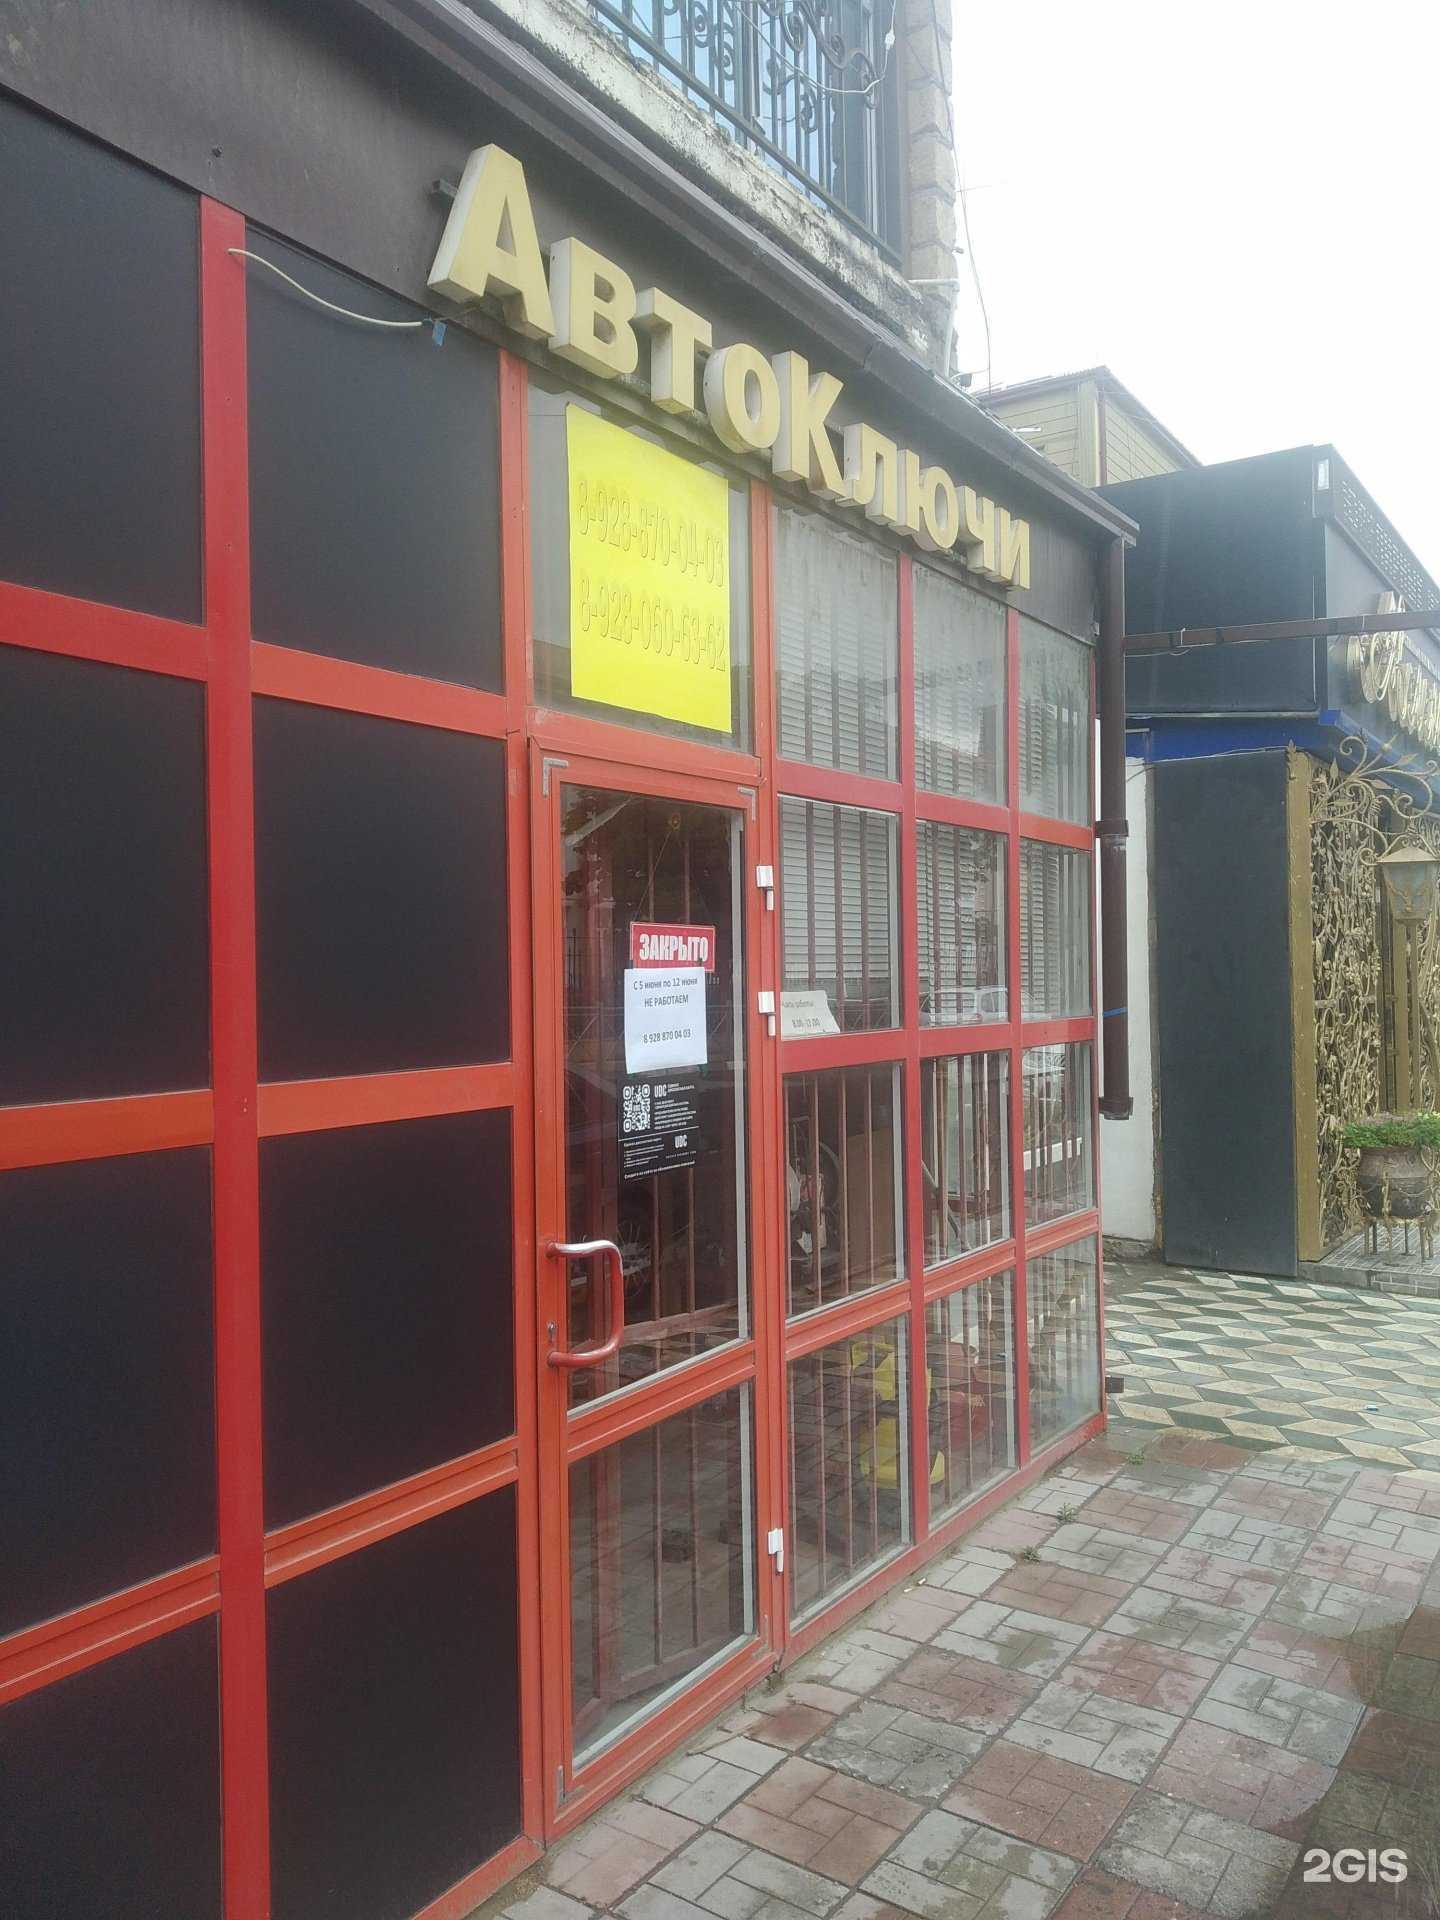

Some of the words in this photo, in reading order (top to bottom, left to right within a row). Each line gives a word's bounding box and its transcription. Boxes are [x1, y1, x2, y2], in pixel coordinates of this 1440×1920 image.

[640, 934, 708, 962] ЗАКРЫТО
[672, 978, 680, 986] 12
[644, 998, 653, 1007] НЕ
[655, 994, 688, 1006] РАБОТАЕМ
[649, 1033, 660, 1043] 928
[662, 1031, 673, 1041] 870
[674, 1030, 682, 1039] 04
[654, 1084, 667, 1098] UDC
[675, 1135, 688, 1148] UDC
